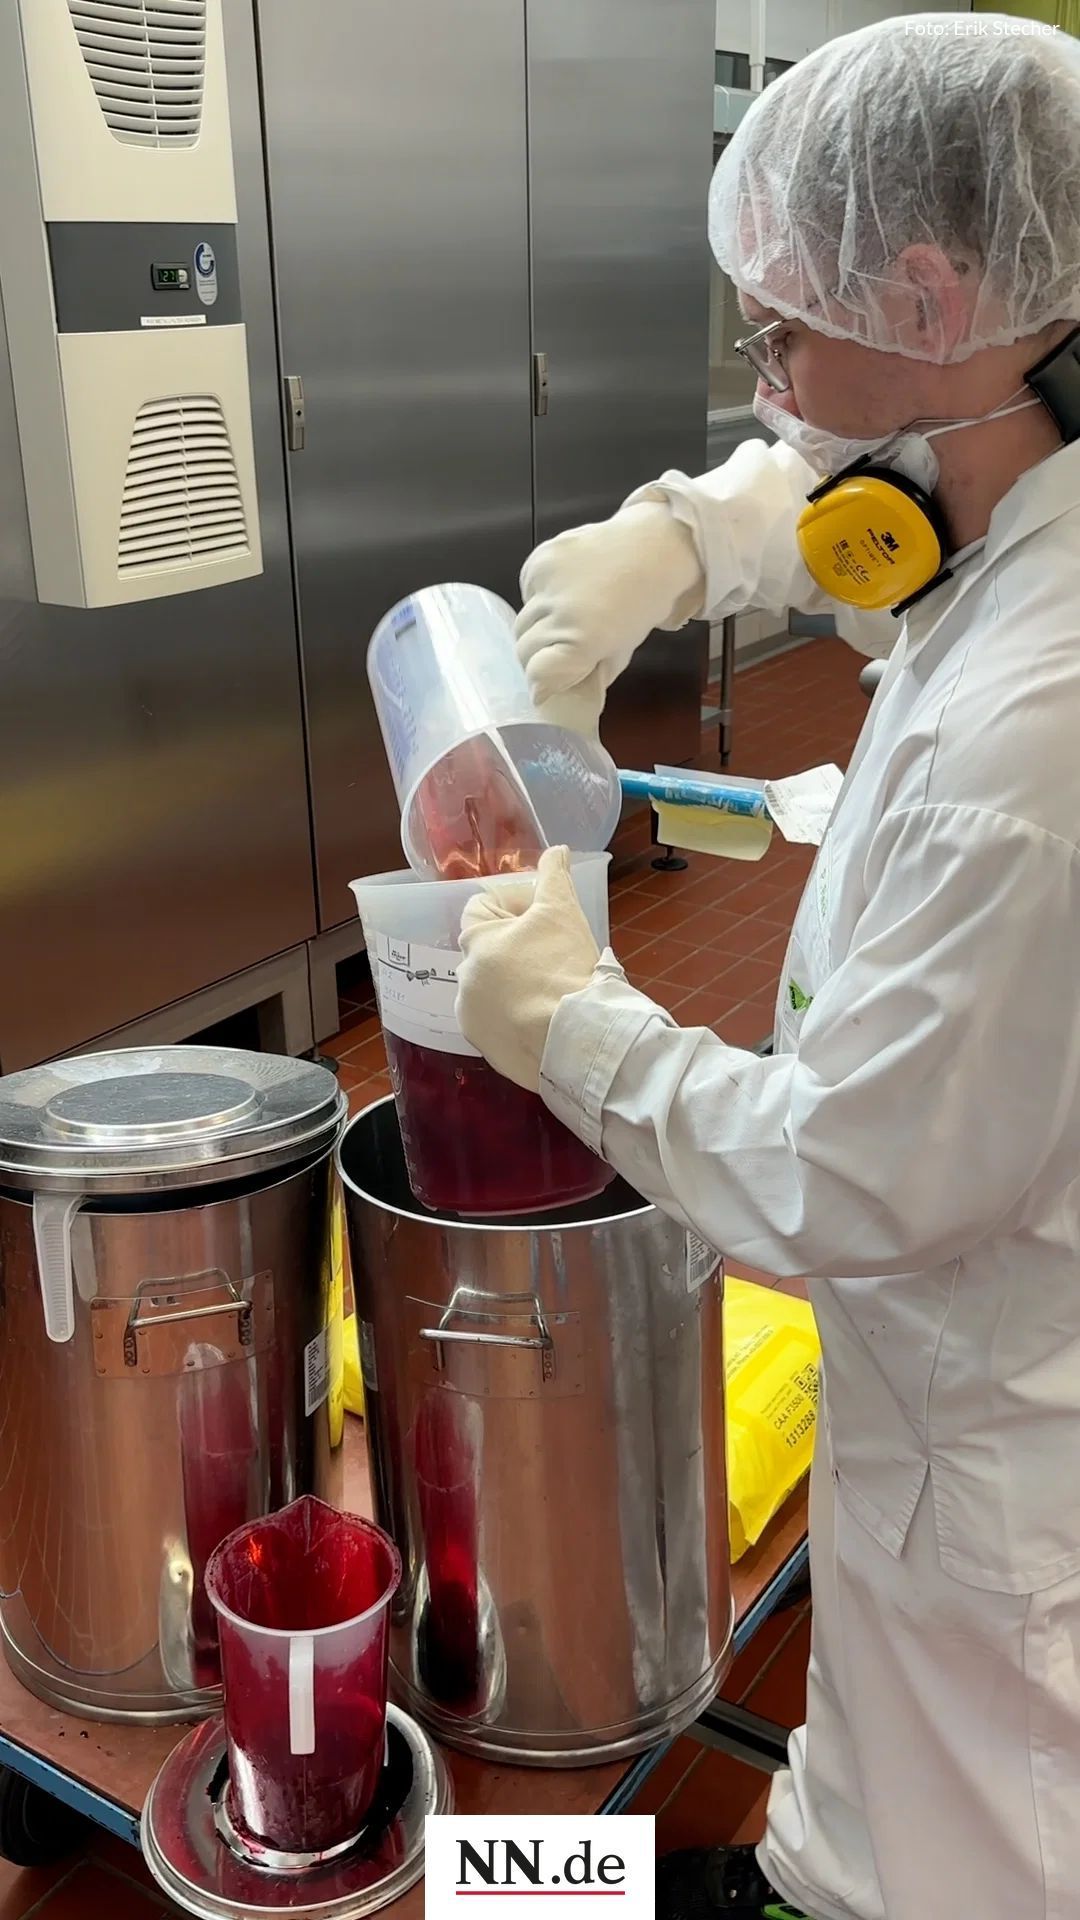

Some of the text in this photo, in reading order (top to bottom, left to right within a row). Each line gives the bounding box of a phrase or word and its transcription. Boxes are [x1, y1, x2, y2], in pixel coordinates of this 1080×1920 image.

[866, 528, 896, 565] PELTOR
[881, 531, 900, 552] 3M
[774, 1413, 788, 1430] CAA
